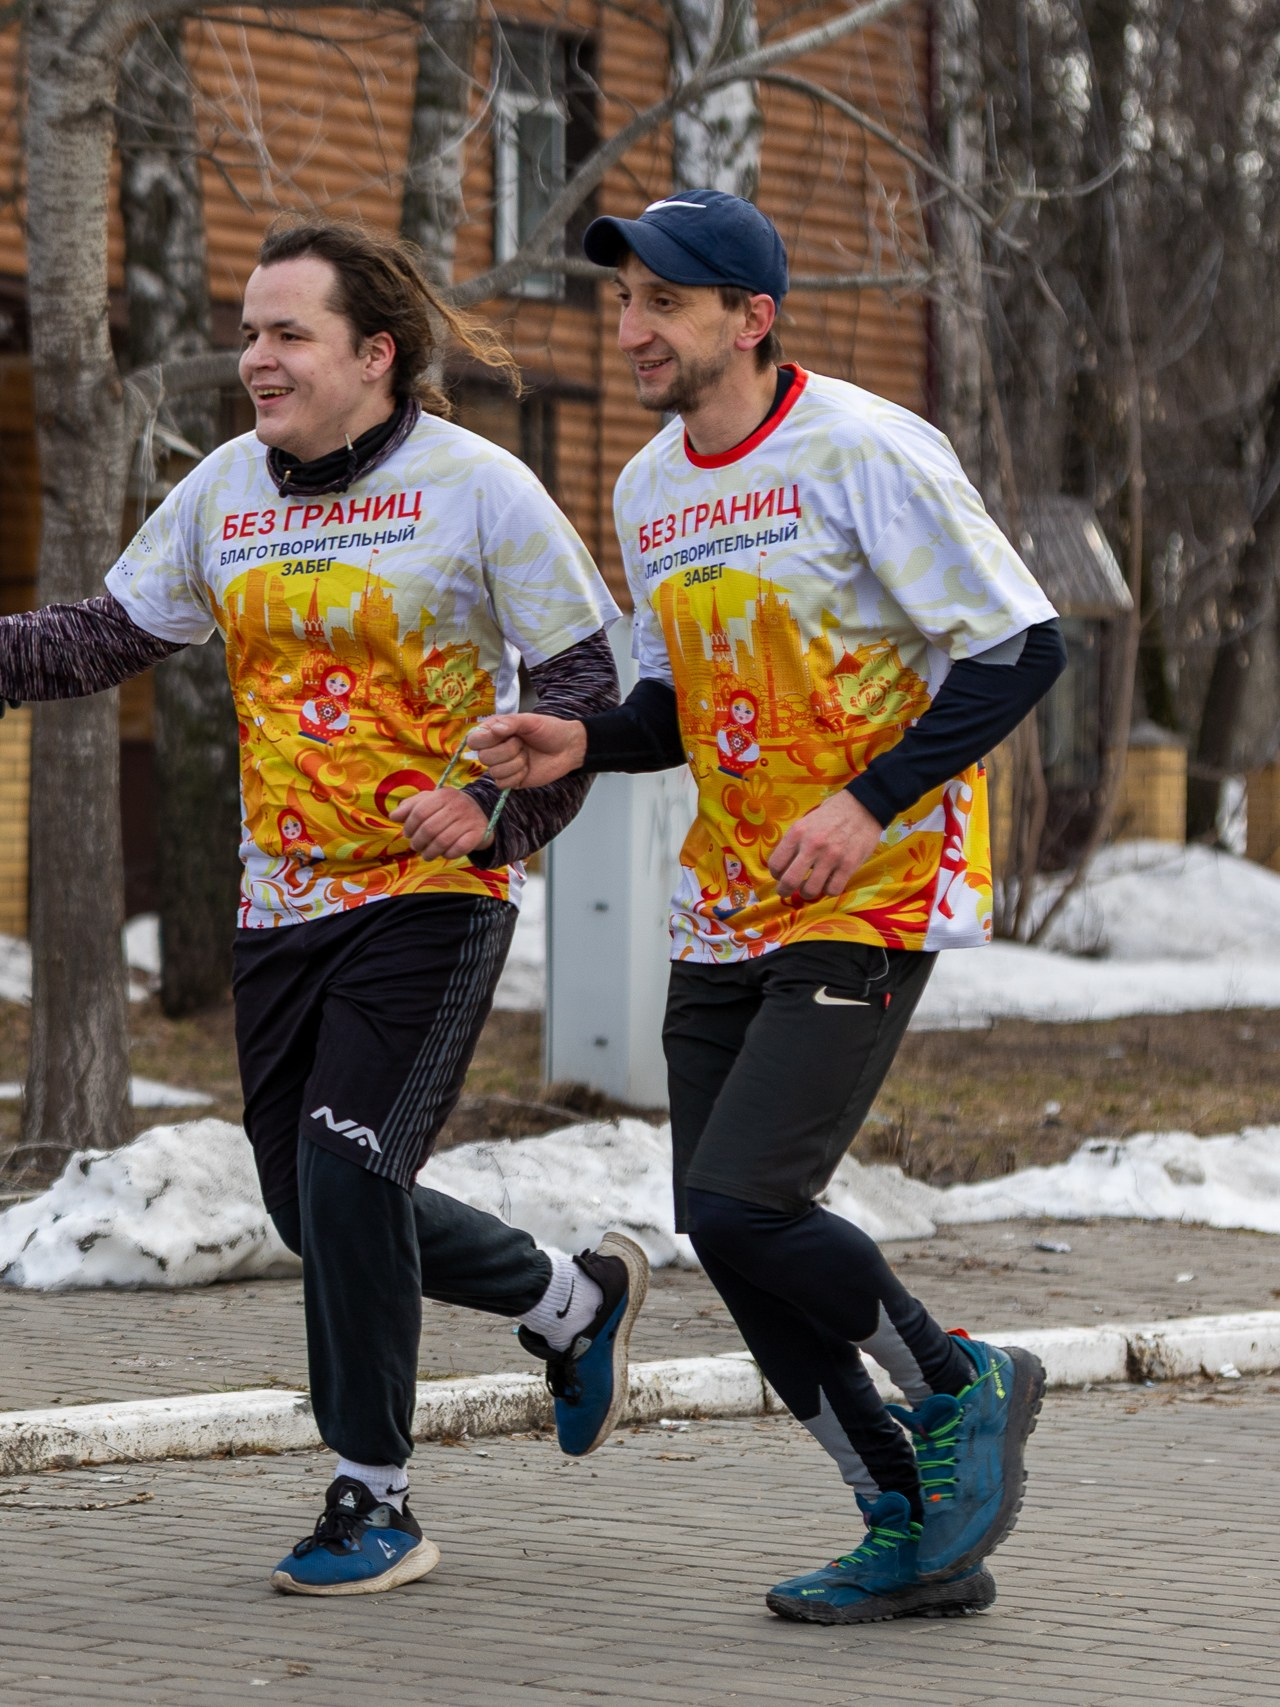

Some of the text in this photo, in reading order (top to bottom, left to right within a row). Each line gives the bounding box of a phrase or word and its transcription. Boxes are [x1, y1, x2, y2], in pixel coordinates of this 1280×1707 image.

[222, 491, 422, 541] БЕЗ ГРАНИЦ
[639, 484, 802, 554] БЕЗ ГРАНИЦ
[220, 524, 417, 566] БЛАГОТВОРИТЕЛЬНЫЙ
[281, 556, 337, 577] ЗАБЕГ
[645, 522, 799, 579] ЛАГОТВОРИТЕЛЬНЫЙ
[684, 562, 726, 588] ЗАБЕГ
